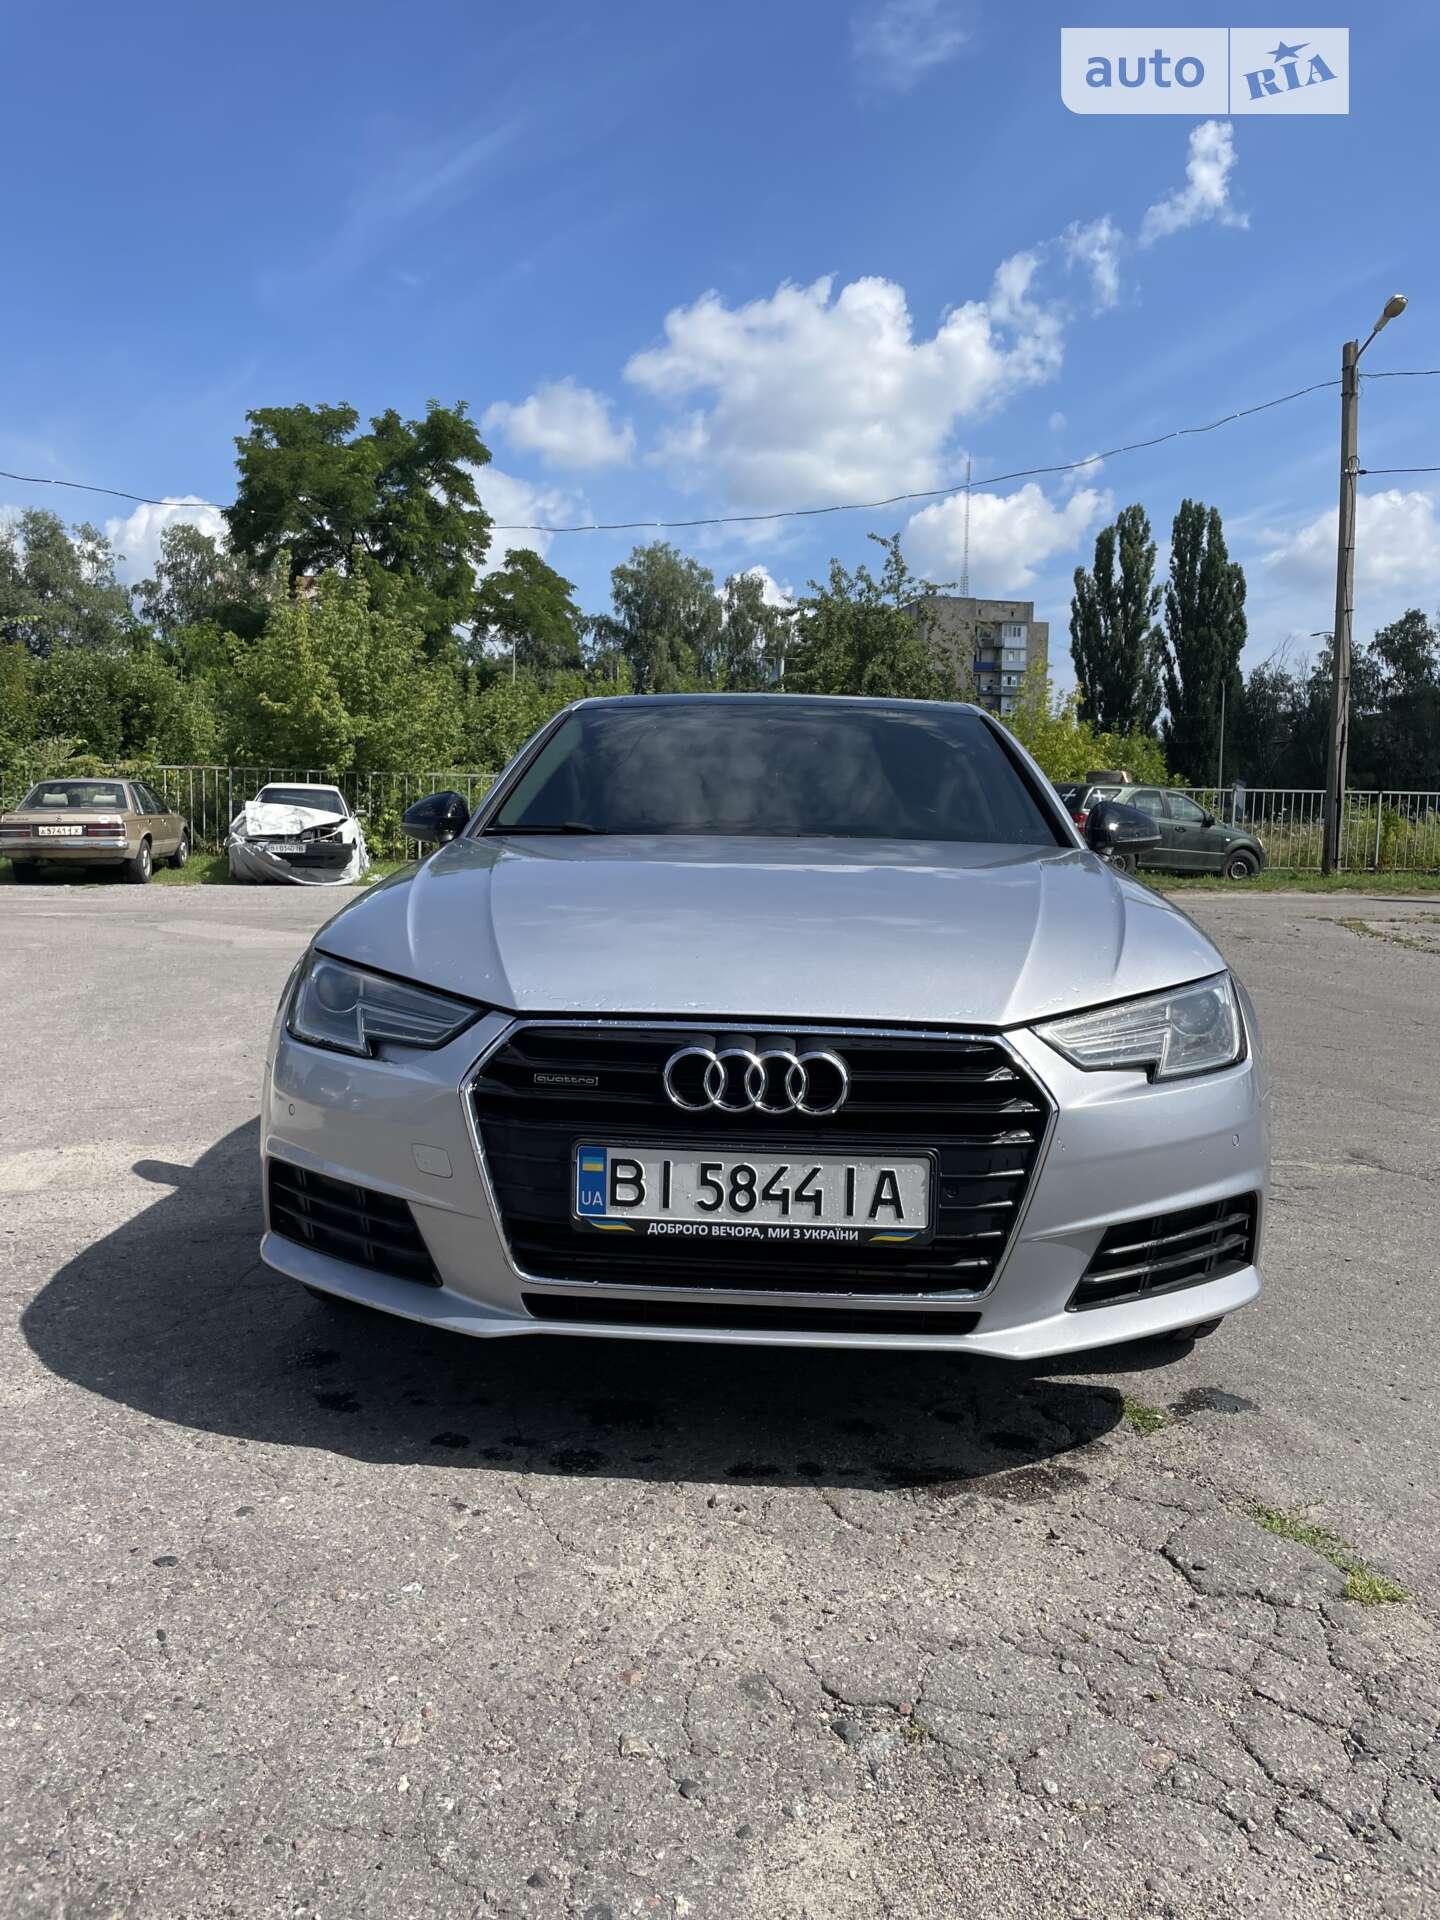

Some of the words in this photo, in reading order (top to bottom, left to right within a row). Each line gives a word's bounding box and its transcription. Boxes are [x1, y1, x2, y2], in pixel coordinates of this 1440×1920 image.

[536, 1075, 596, 1085] quattro
[609, 1158, 673, 1210] BI
[696, 1161, 824, 1217] 5844
[846, 1165, 906, 1220] IA
[582, 1190, 603, 1206] UA
[647, 1222, 708, 1236] ДОБРОГО
[711, 1224, 764, 1240] ВЕЧОРА,
[767, 1228, 790, 1239] МИ
[803, 1227, 859, 1241] УКРАЇНИ
